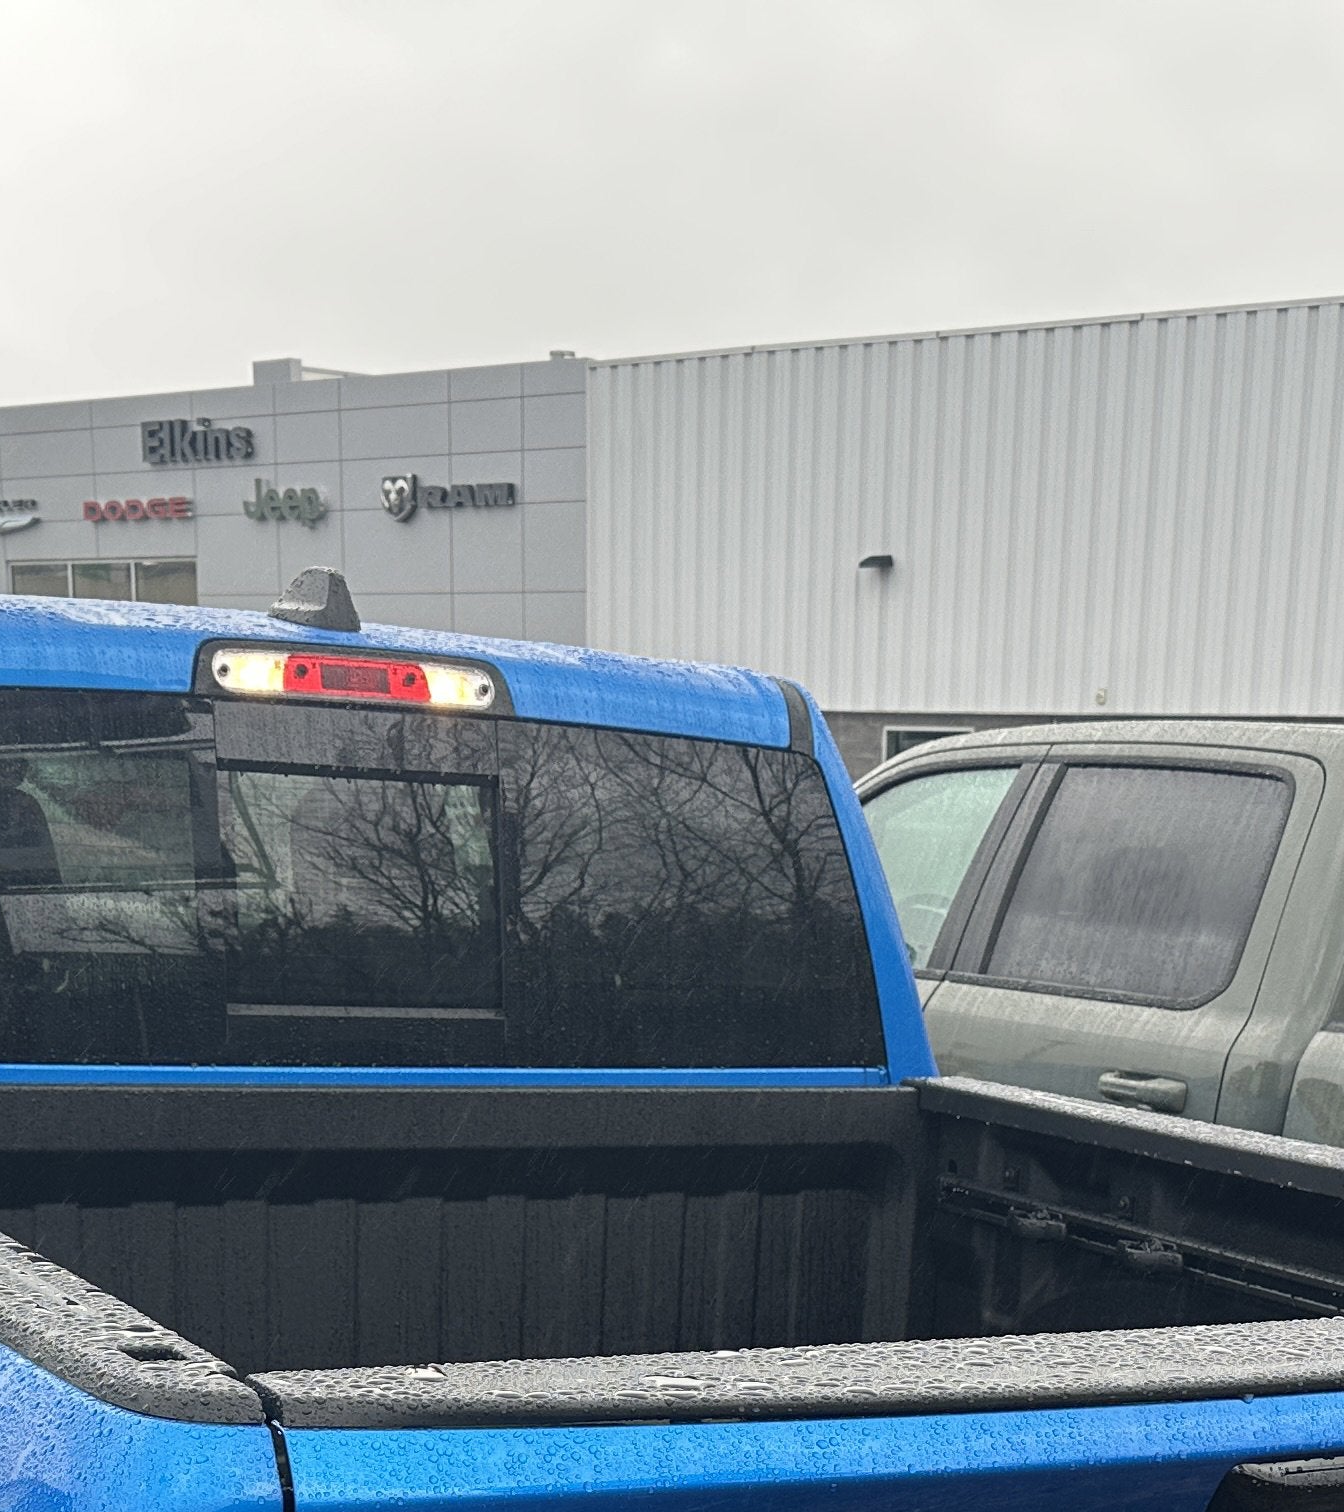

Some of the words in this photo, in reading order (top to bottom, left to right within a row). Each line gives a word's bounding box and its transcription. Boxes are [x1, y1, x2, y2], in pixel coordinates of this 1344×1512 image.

[141, 417, 254, 465] Elkins
[83, 497, 194, 521] DODGE
[243, 478, 329, 529] Jeep
[418, 483, 515, 508] RAM
